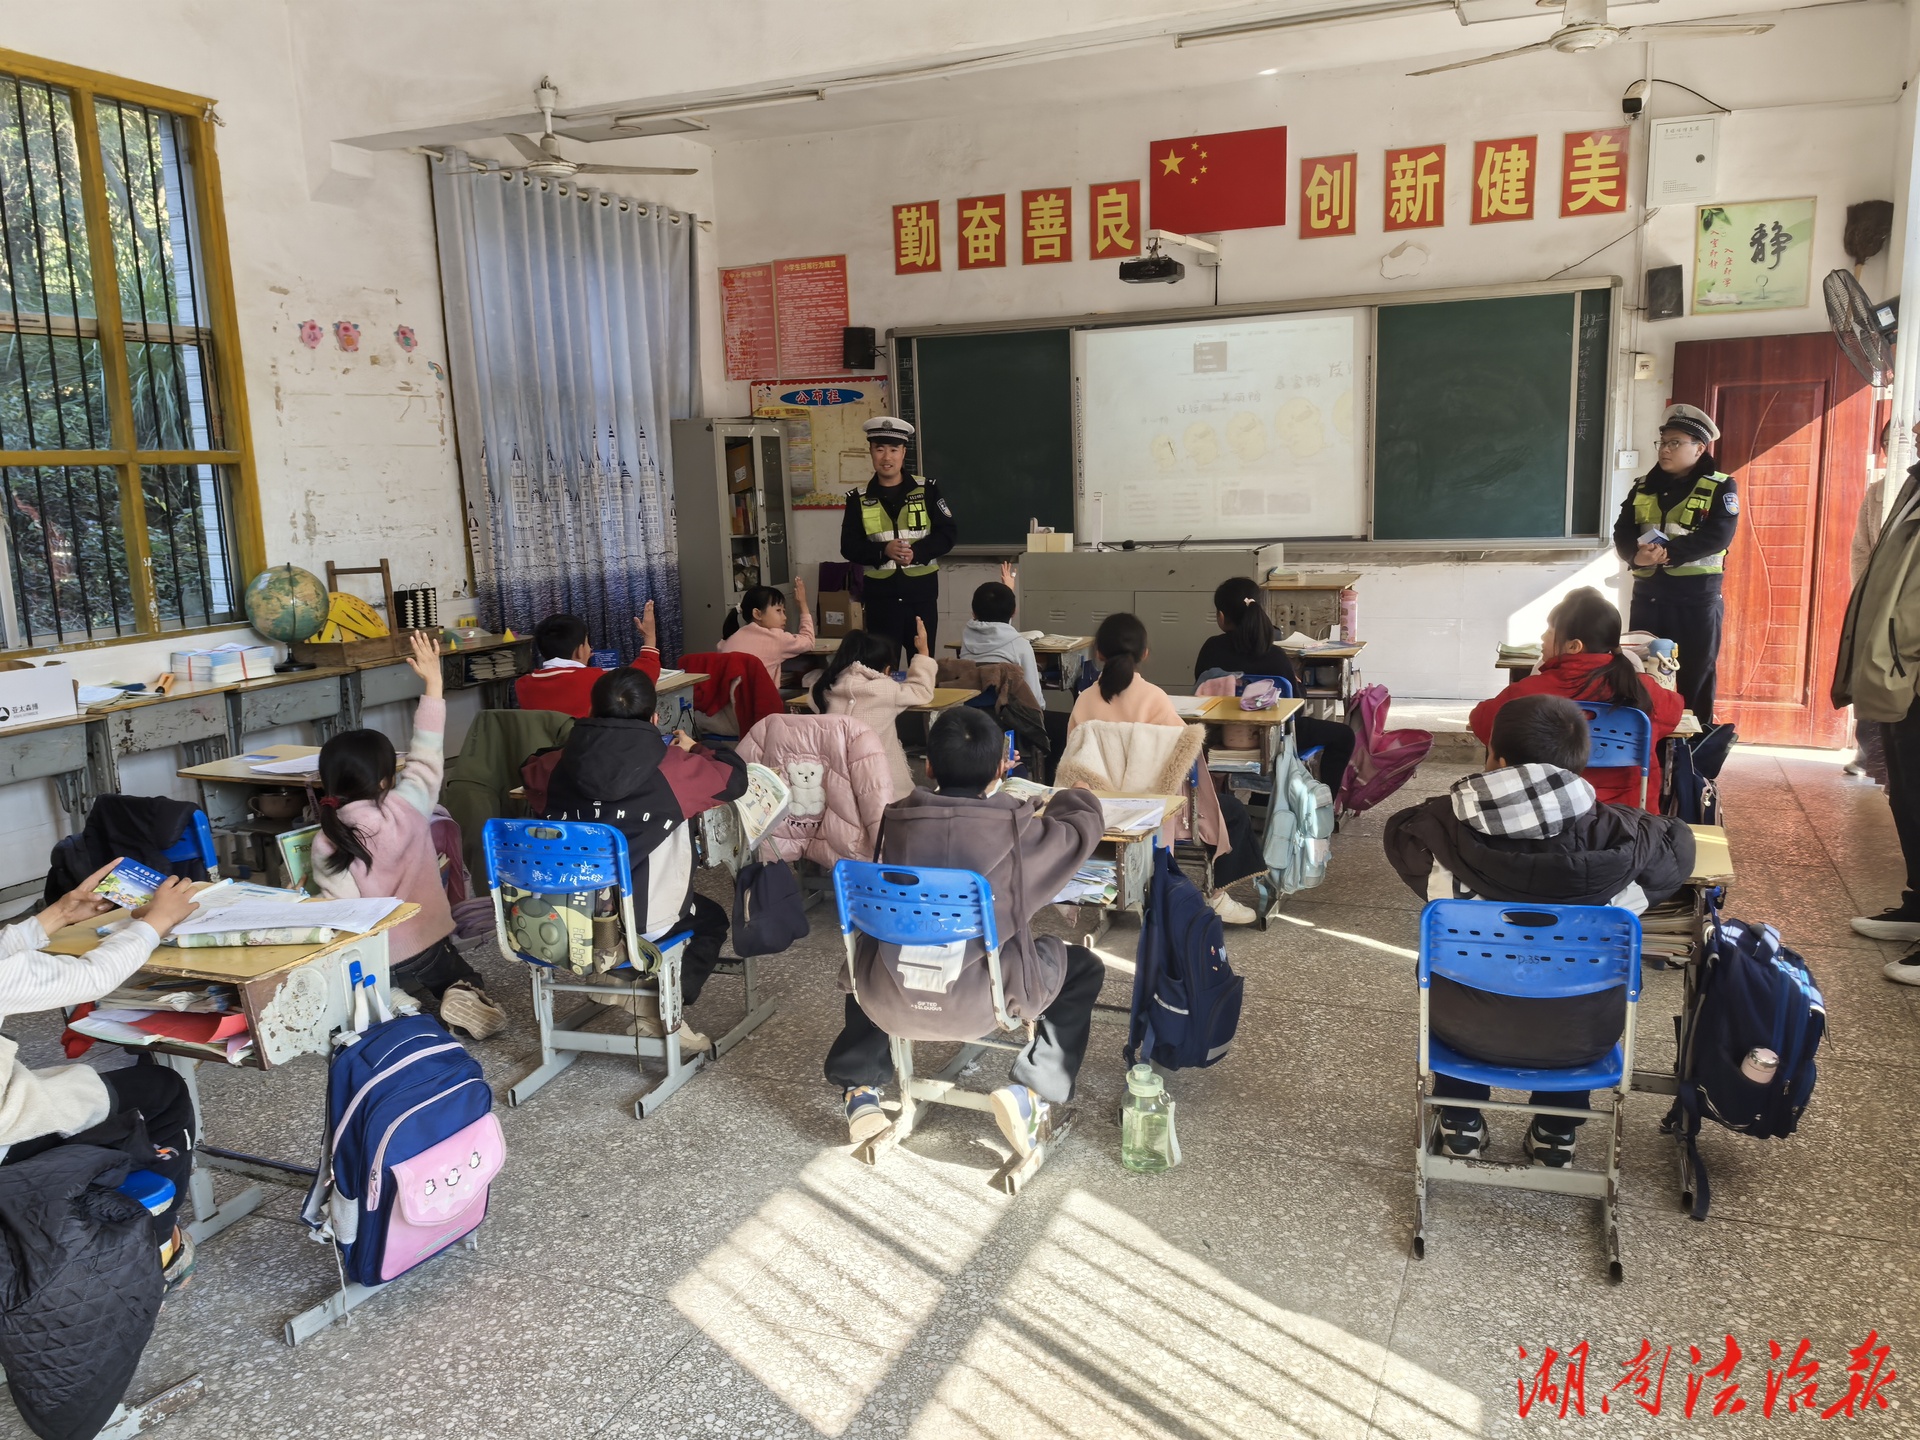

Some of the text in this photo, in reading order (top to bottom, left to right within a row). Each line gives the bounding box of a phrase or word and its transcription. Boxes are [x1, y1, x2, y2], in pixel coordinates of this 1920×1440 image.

[1305, 136, 1621, 229] 创新健美
[896, 187, 1135, 268] 勤奋善良
[1749, 220, 1793, 270] 静
[795, 388, 842, 406] 公布栏
